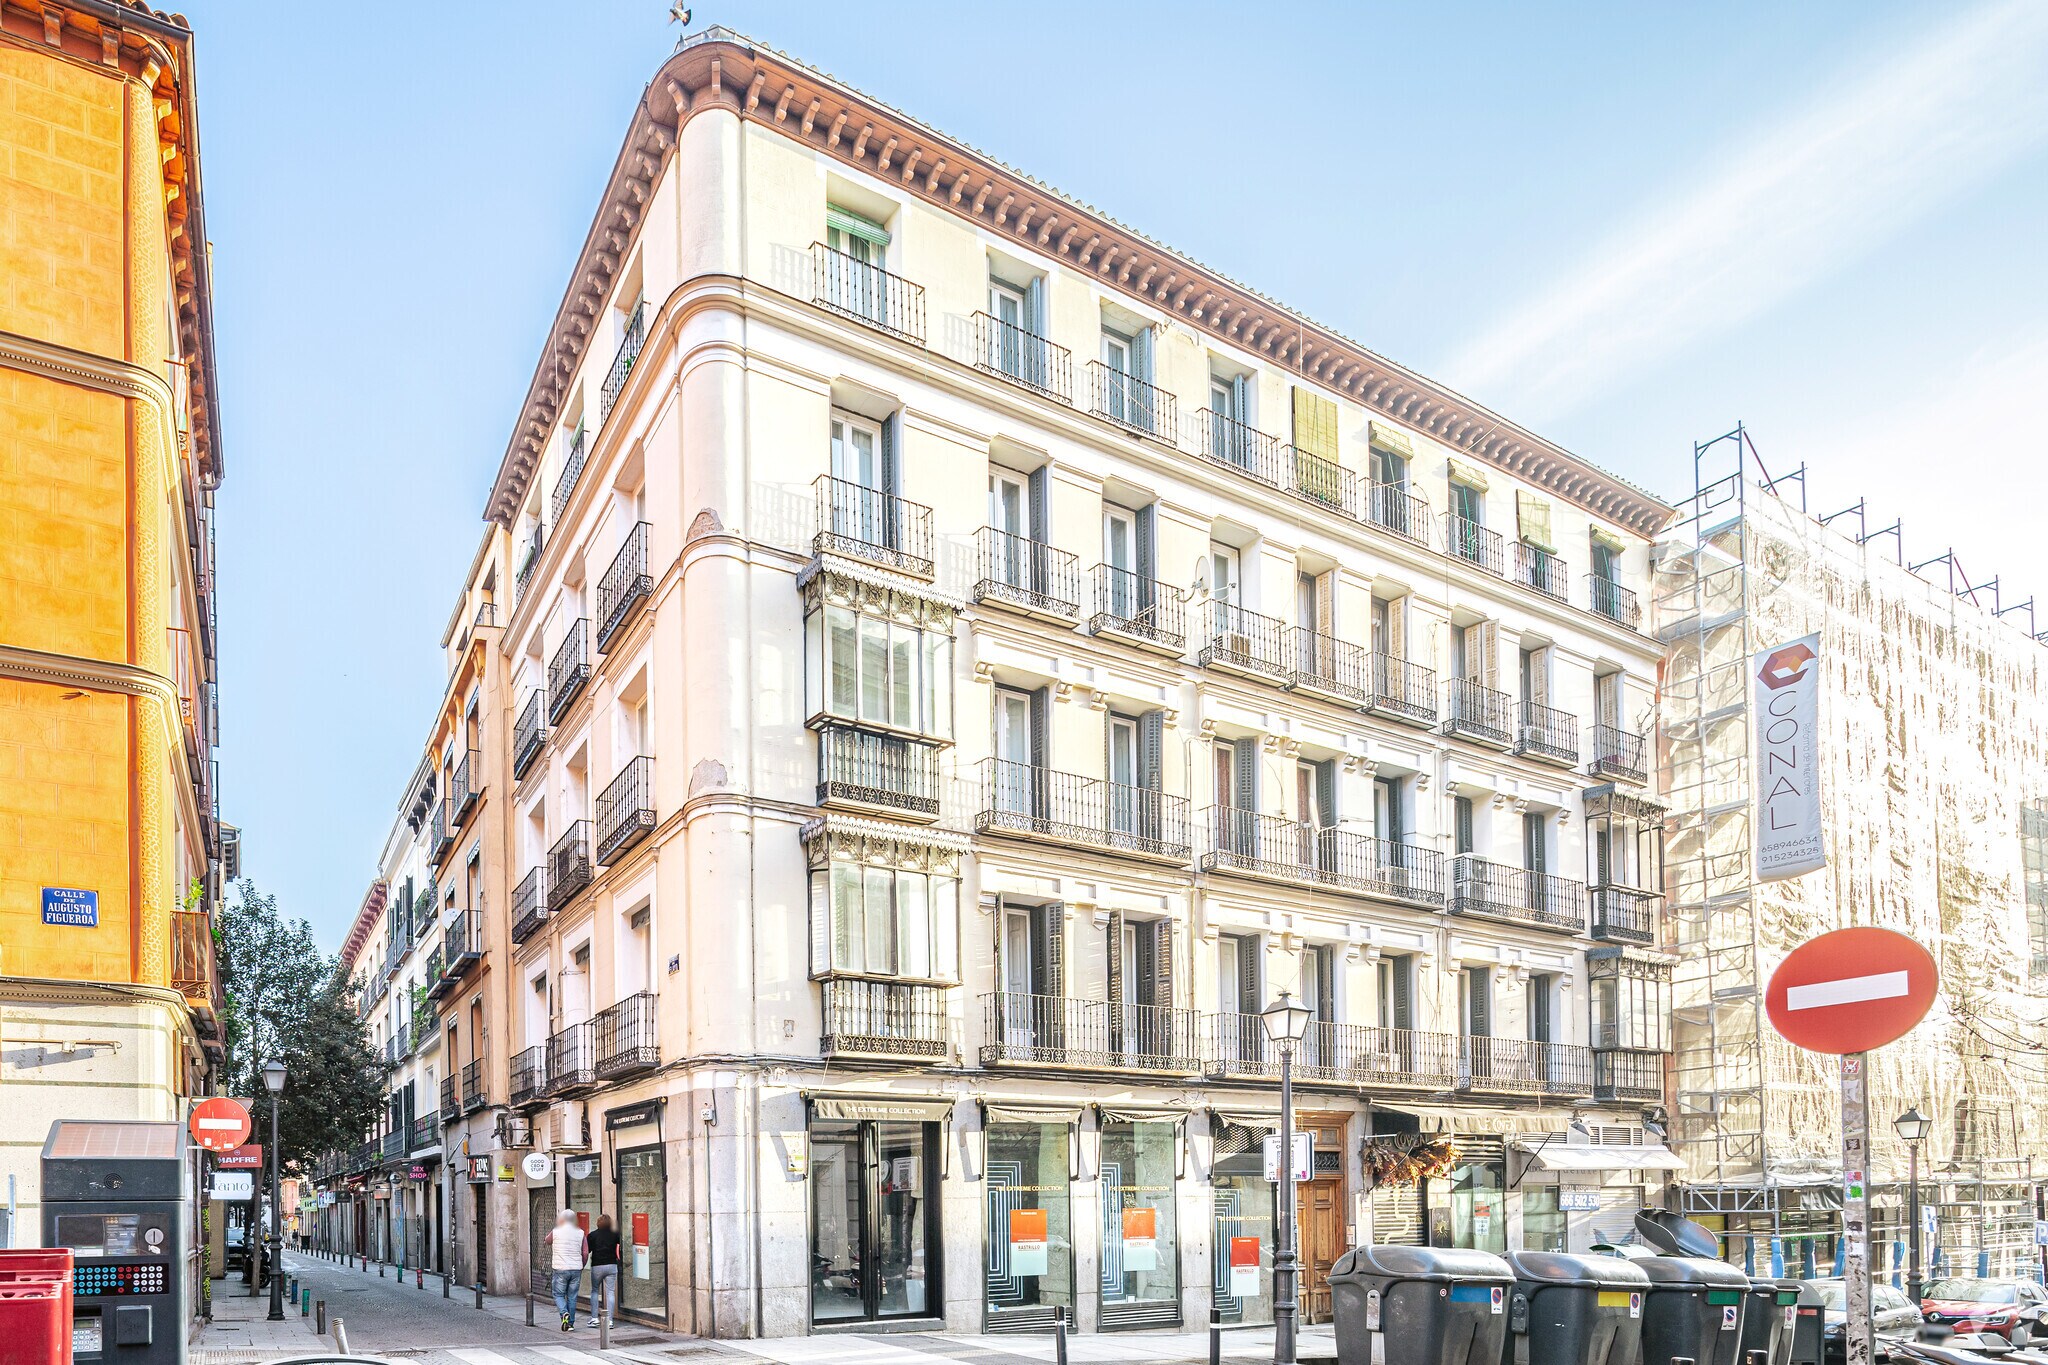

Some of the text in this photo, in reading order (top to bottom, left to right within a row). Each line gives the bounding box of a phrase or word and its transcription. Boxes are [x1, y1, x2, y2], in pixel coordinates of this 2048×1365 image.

[1766, 690, 1801, 830] CONAL
[1761, 836, 1818, 853] 658946634
[1761, 847, 1819, 864] 915234325
[54, 890, 85, 898] CALLE
[47, 902, 92, 914] AUGUSTO
[46, 912, 94, 925] FIGUEROA
[889, 1107, 926, 1115] COLLECTION
[1493, 1117, 1516, 1133] COVEN
[1394, 1131, 1430, 1149] COVEN
[1560, 1184, 1575, 1192] LOCAL
[1560, 1194, 1600, 1207] 666 502 530
